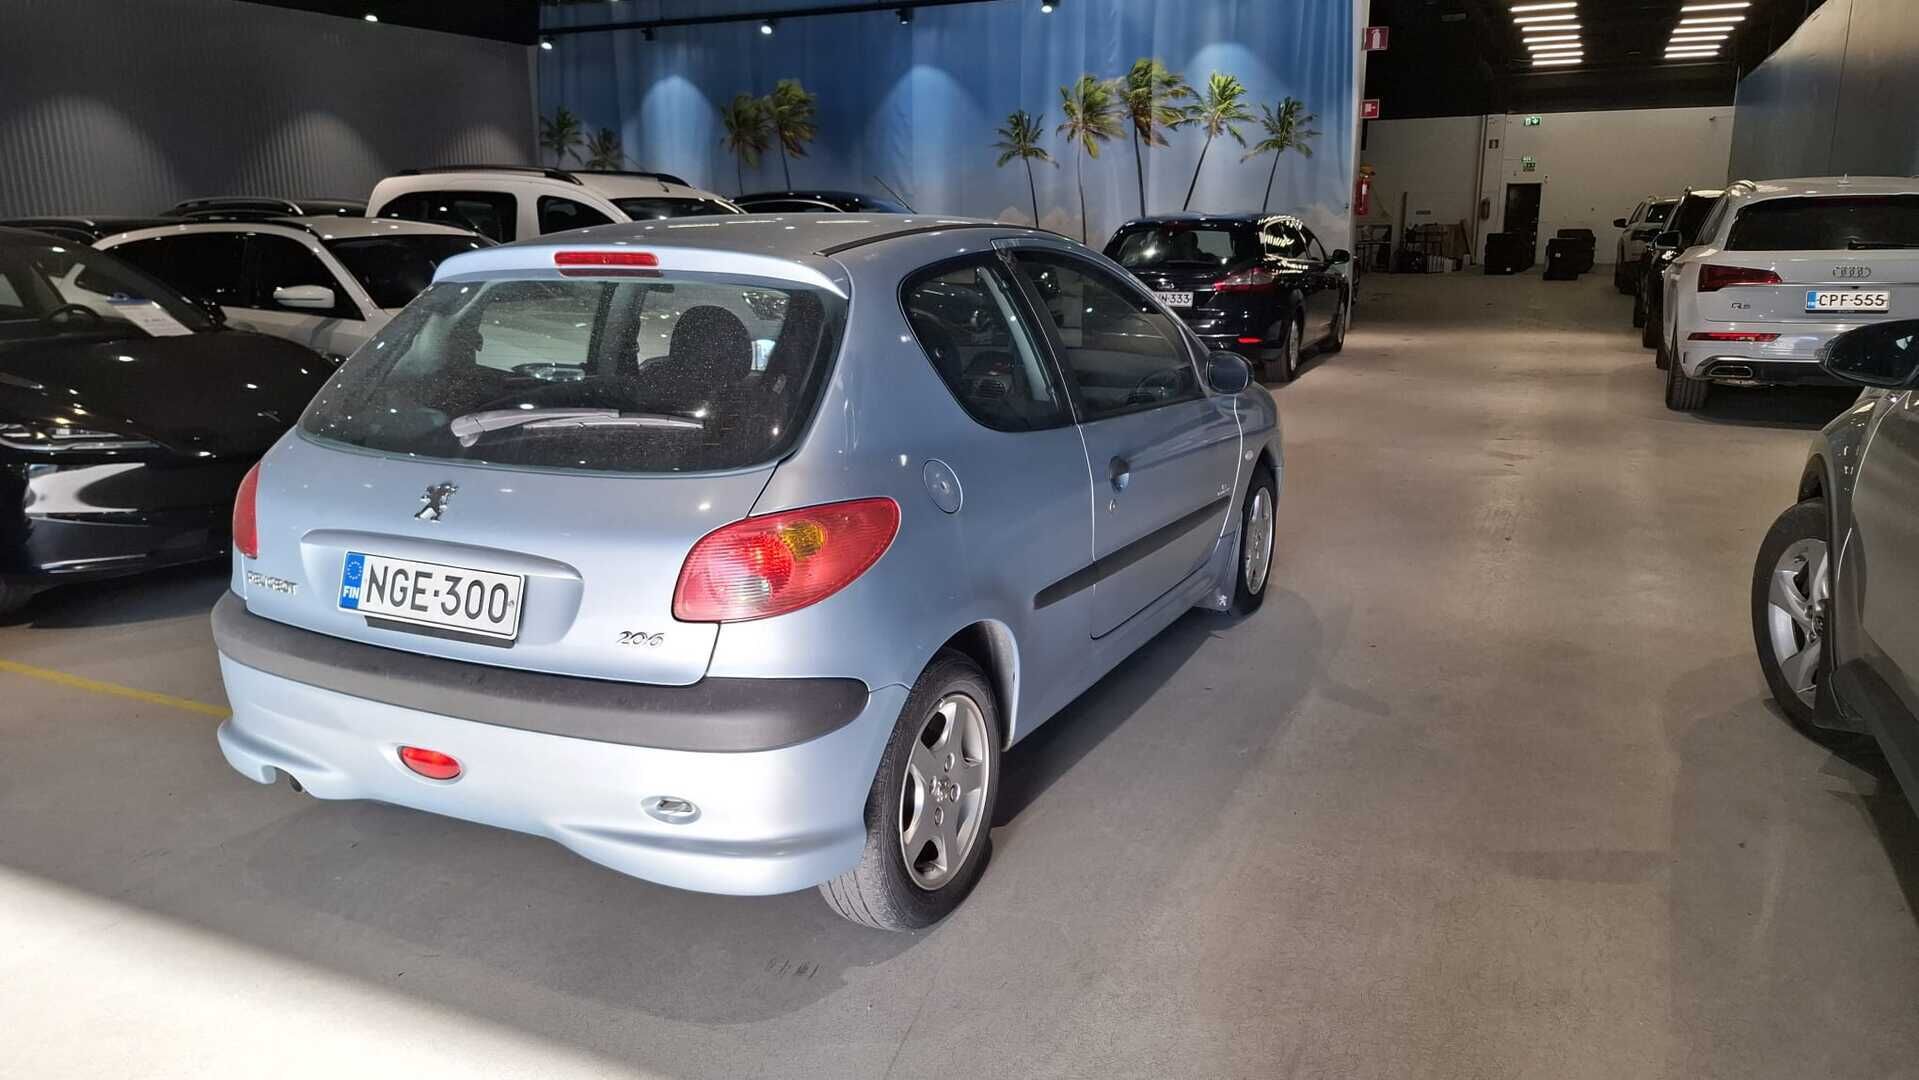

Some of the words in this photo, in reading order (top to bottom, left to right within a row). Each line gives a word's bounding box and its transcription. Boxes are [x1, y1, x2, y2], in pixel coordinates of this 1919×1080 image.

[1157, 293, 1190, 303] N-333
[1819, 294, 1885, 307] CPF-555
[343, 585, 360, 600] FIN
[366, 564, 509, 624] NGE-300
[616, 630, 665, 647] 206
